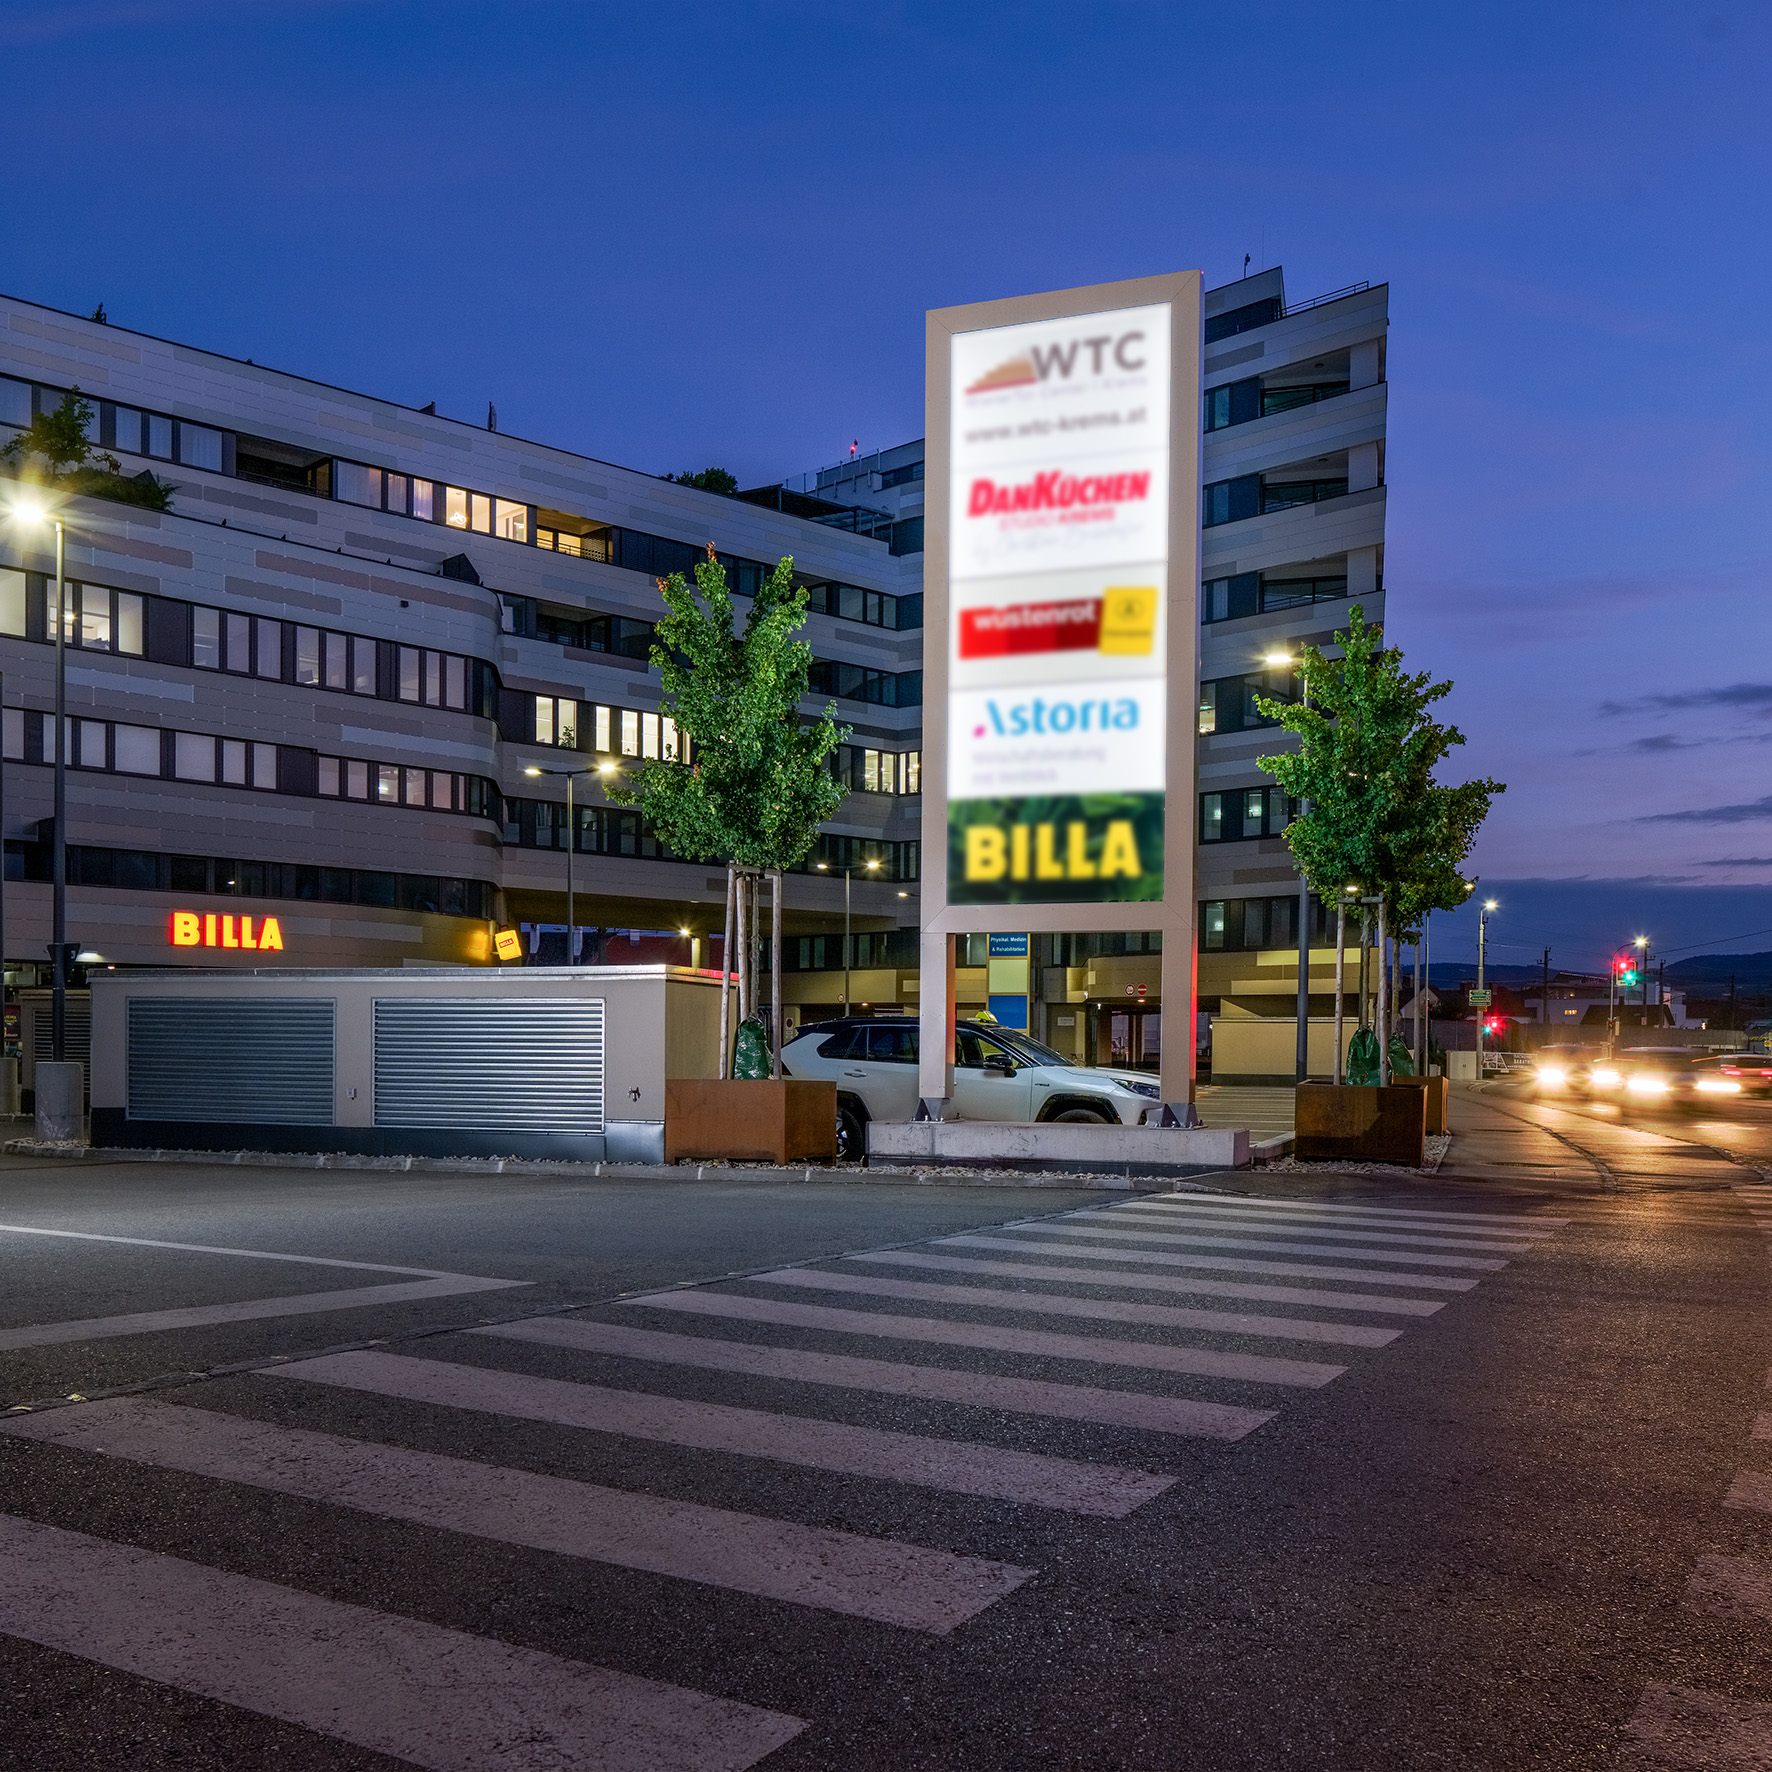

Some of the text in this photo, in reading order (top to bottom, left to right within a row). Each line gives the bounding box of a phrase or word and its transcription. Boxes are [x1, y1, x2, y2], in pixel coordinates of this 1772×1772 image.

[1031, 331, 1146, 381] WTC
[965, 820, 1142, 881] BILLA
[172, 912, 284, 950] BILLA
